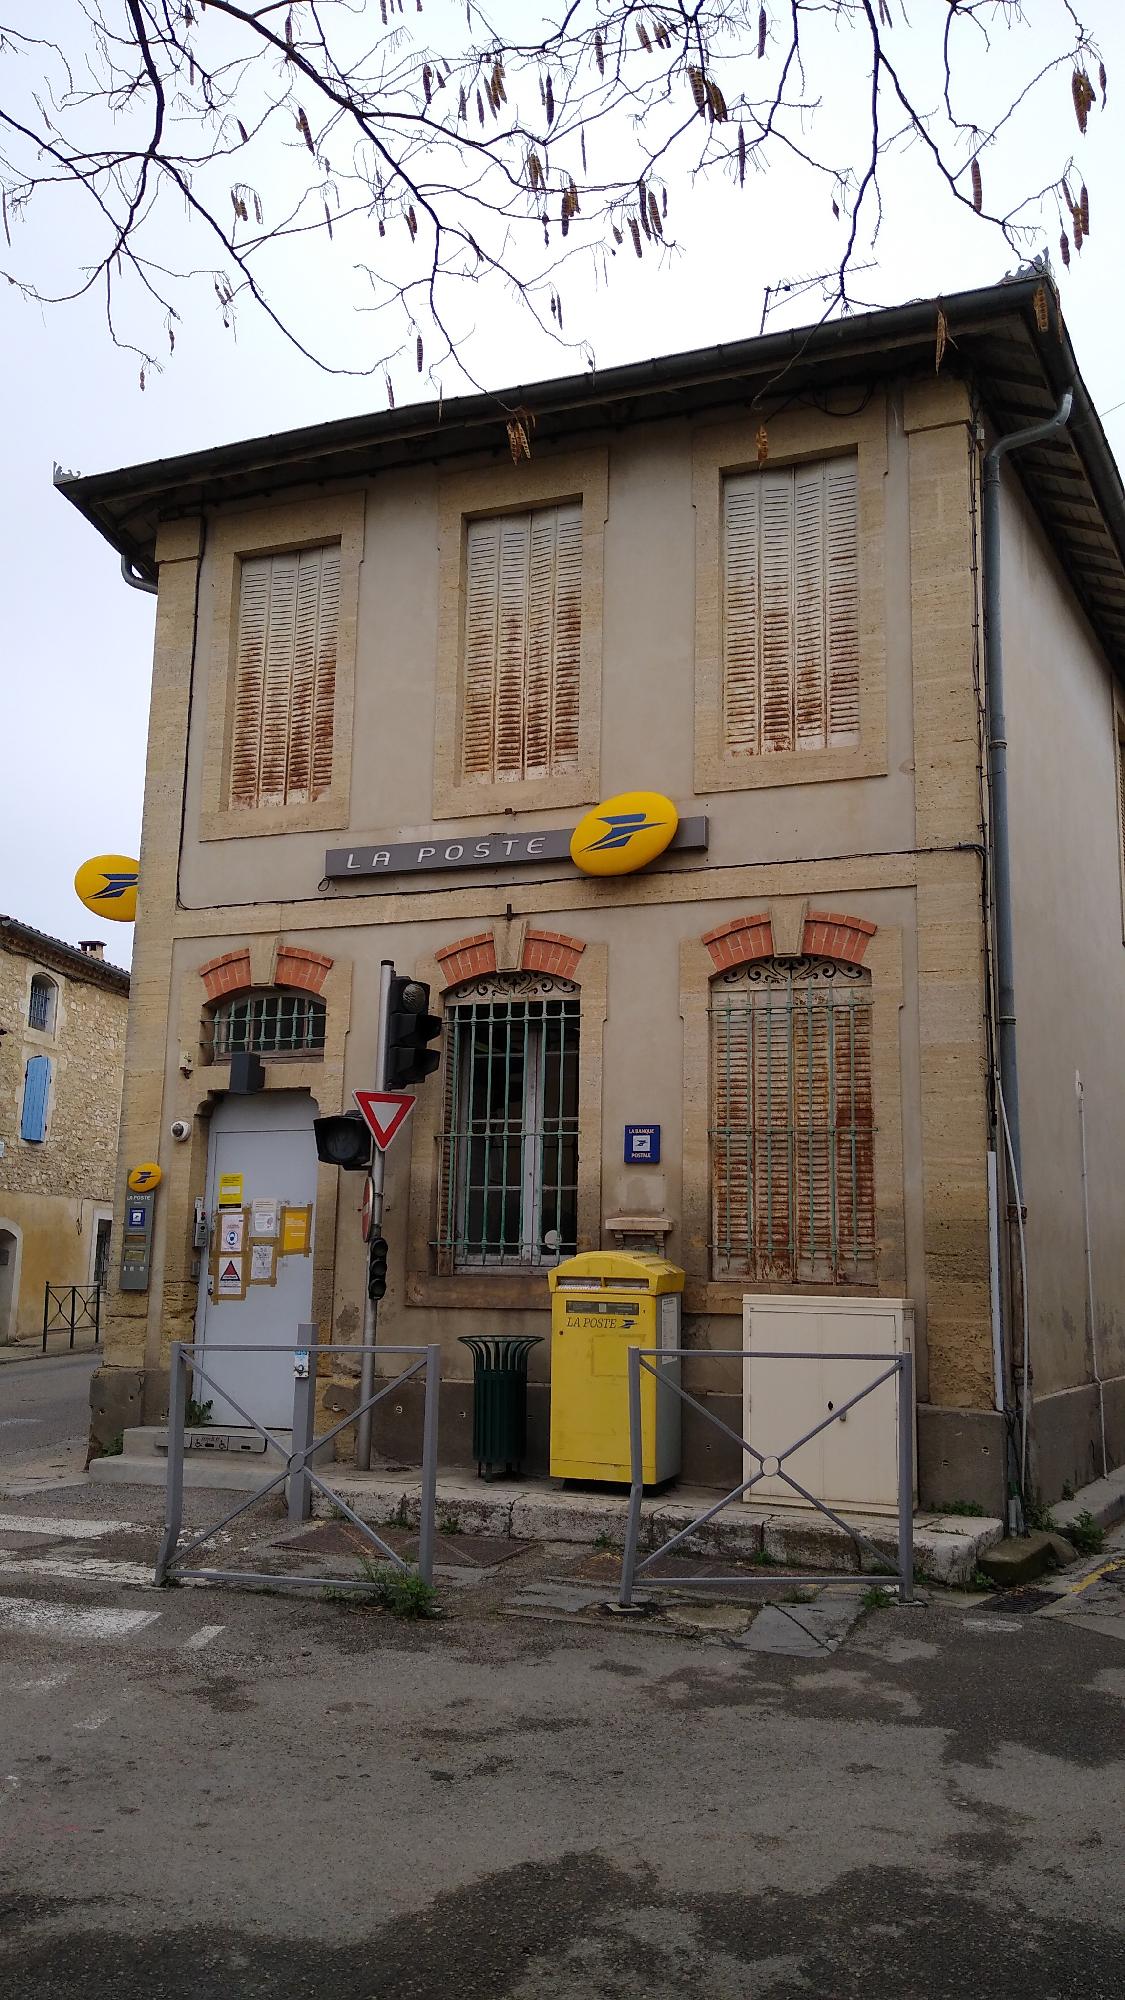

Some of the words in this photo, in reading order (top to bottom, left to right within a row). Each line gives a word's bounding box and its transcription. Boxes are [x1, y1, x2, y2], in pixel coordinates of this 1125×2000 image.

[346, 851, 391, 869] LA
[417, 837, 546, 863] POSTE
[567, 1317, 580, 1328] LA
[583, 1317, 617, 1329] POSTE
